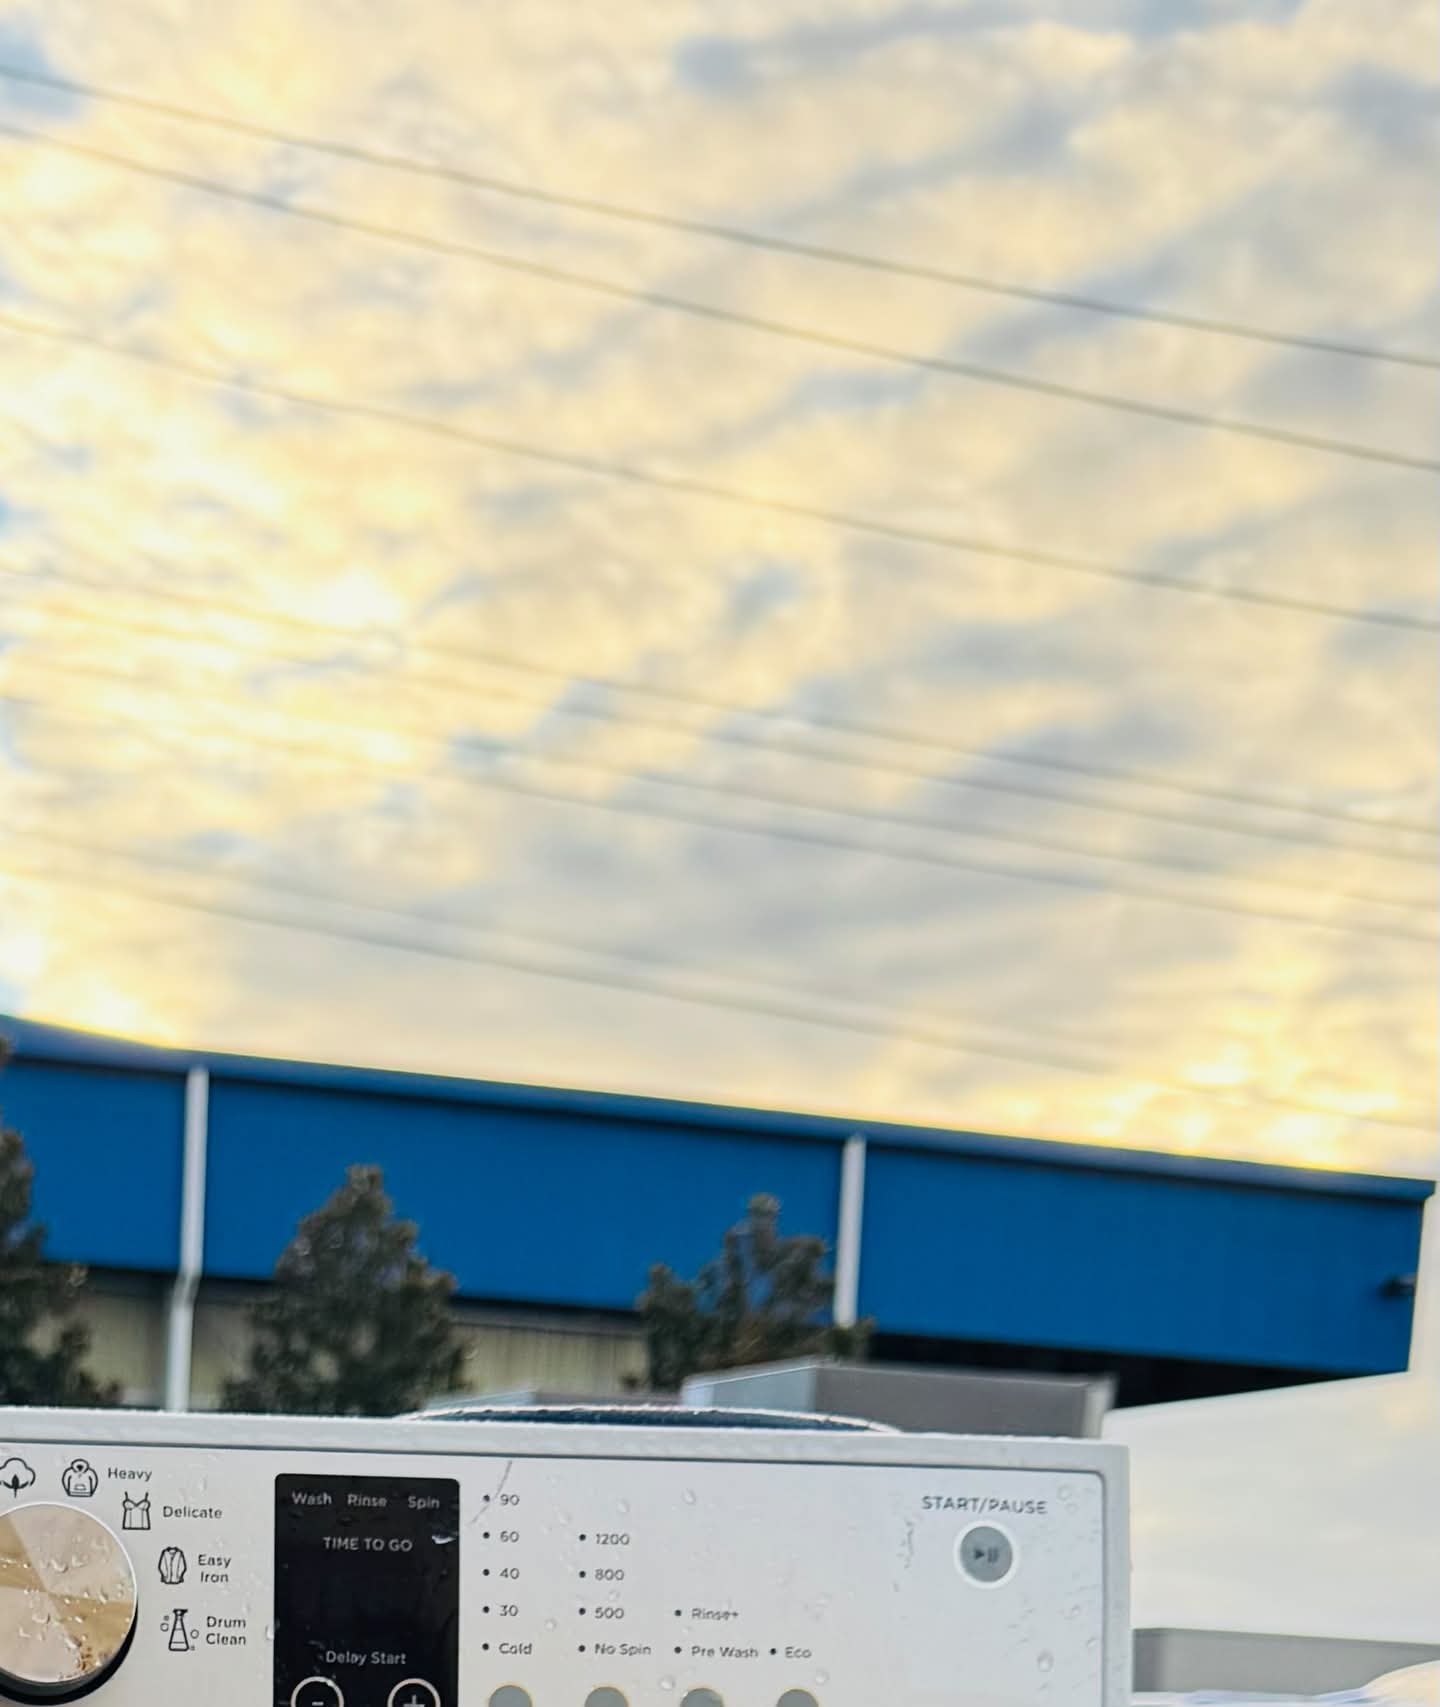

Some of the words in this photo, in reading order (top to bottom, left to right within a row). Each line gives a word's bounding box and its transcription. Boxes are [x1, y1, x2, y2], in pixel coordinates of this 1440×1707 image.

[108, 1467, 152, 1482] Heavy
[292, 1492, 332, 1506] Wash
[347, 1494, 387, 1507] Rinse
[408, 1496, 440, 1510] Spin
[500, 1494, 519, 1506] 90
[921, 1495, 1047, 1515] START/PAUSE
[163, 1506, 222, 1519] Delicate
[500, 1531, 519, 1542] 60
[595, 1534, 630, 1545] 1200
[323, 1537, 358, 1550] TIME
[364, 1538, 384, 1550] TO
[388, 1539, 413, 1551] GO
[198, 1554, 231, 1568] Easy
[200, 1572, 229, 1583] Iron
[500, 1568, 519, 1579] 40
[595, 1569, 624, 1581] 800
[500, 1605, 518, 1617] 30
[594, 1608, 624, 1620] 500
[206, 1616, 246, 1628] Drum
[206, 1633, 246, 1645] Clean
[499, 1643, 532, 1655] Cold
[594, 1644, 615, 1655] No
[619, 1644, 651, 1656] Spin
[691, 1646, 715, 1657] Pre
[720, 1647, 758, 1658] Wash
[785, 1648, 811, 1658] Eco
[326, 1651, 365, 1666] Delay
[371, 1652, 406, 1665] Start
